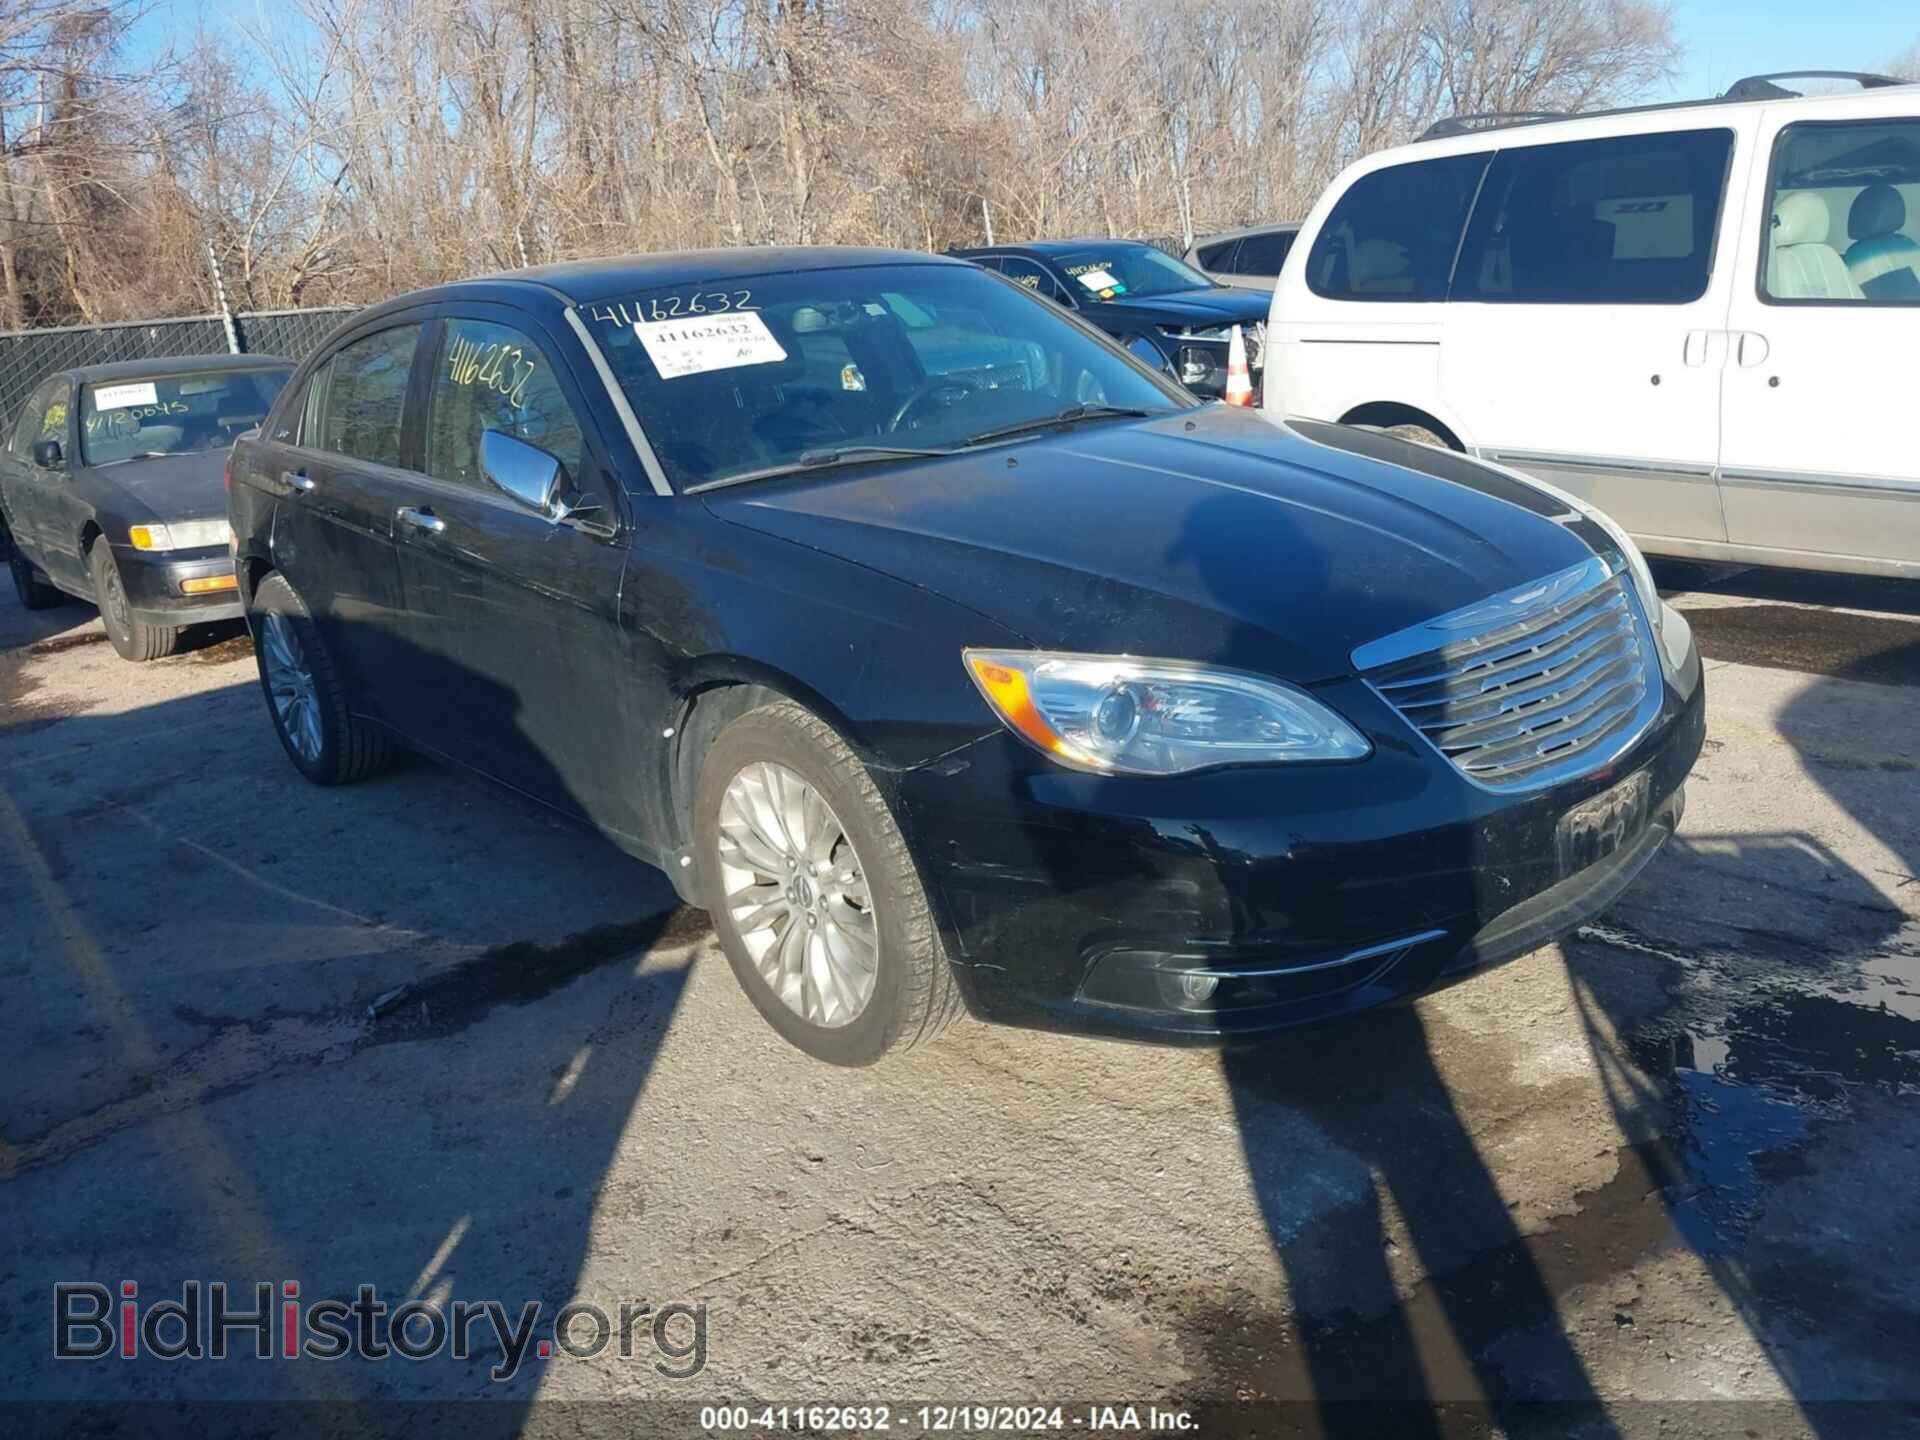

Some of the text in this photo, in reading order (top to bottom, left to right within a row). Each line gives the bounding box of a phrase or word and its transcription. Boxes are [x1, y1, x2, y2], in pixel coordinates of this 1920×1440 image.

[592, 290, 762, 327] 41162632
[655, 324, 752, 343] 41162632
[449, 333, 534, 408] 41162632
